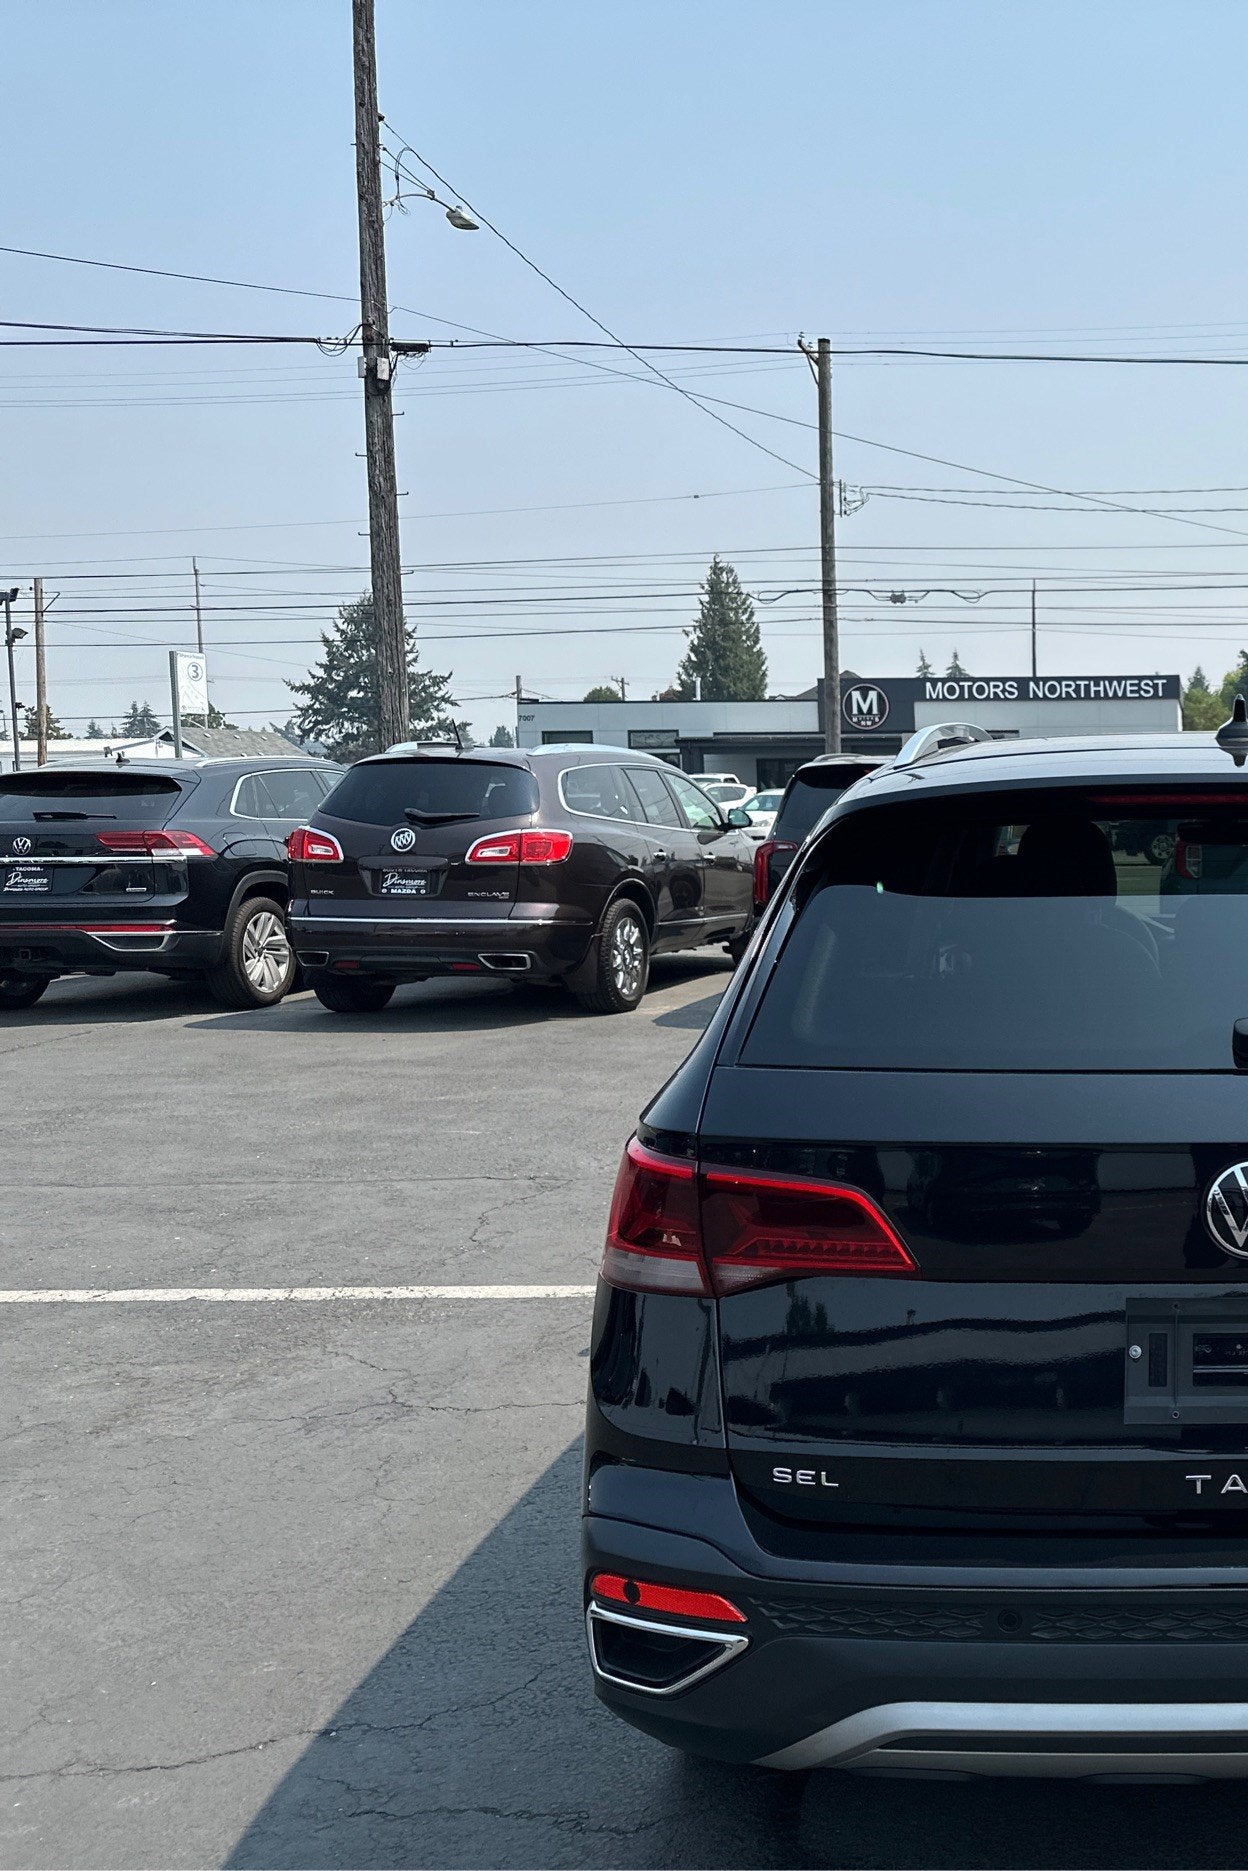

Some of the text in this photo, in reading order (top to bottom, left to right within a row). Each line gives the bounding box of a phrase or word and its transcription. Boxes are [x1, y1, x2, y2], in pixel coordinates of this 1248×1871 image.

[191, 664, 199, 679] 3
[925, 679, 1167, 699] MOTORS NORTHWEST
[851, 690, 878, 715] M
[518, 714, 535, 722] 7007
[773, 1467, 839, 1486] SEL
